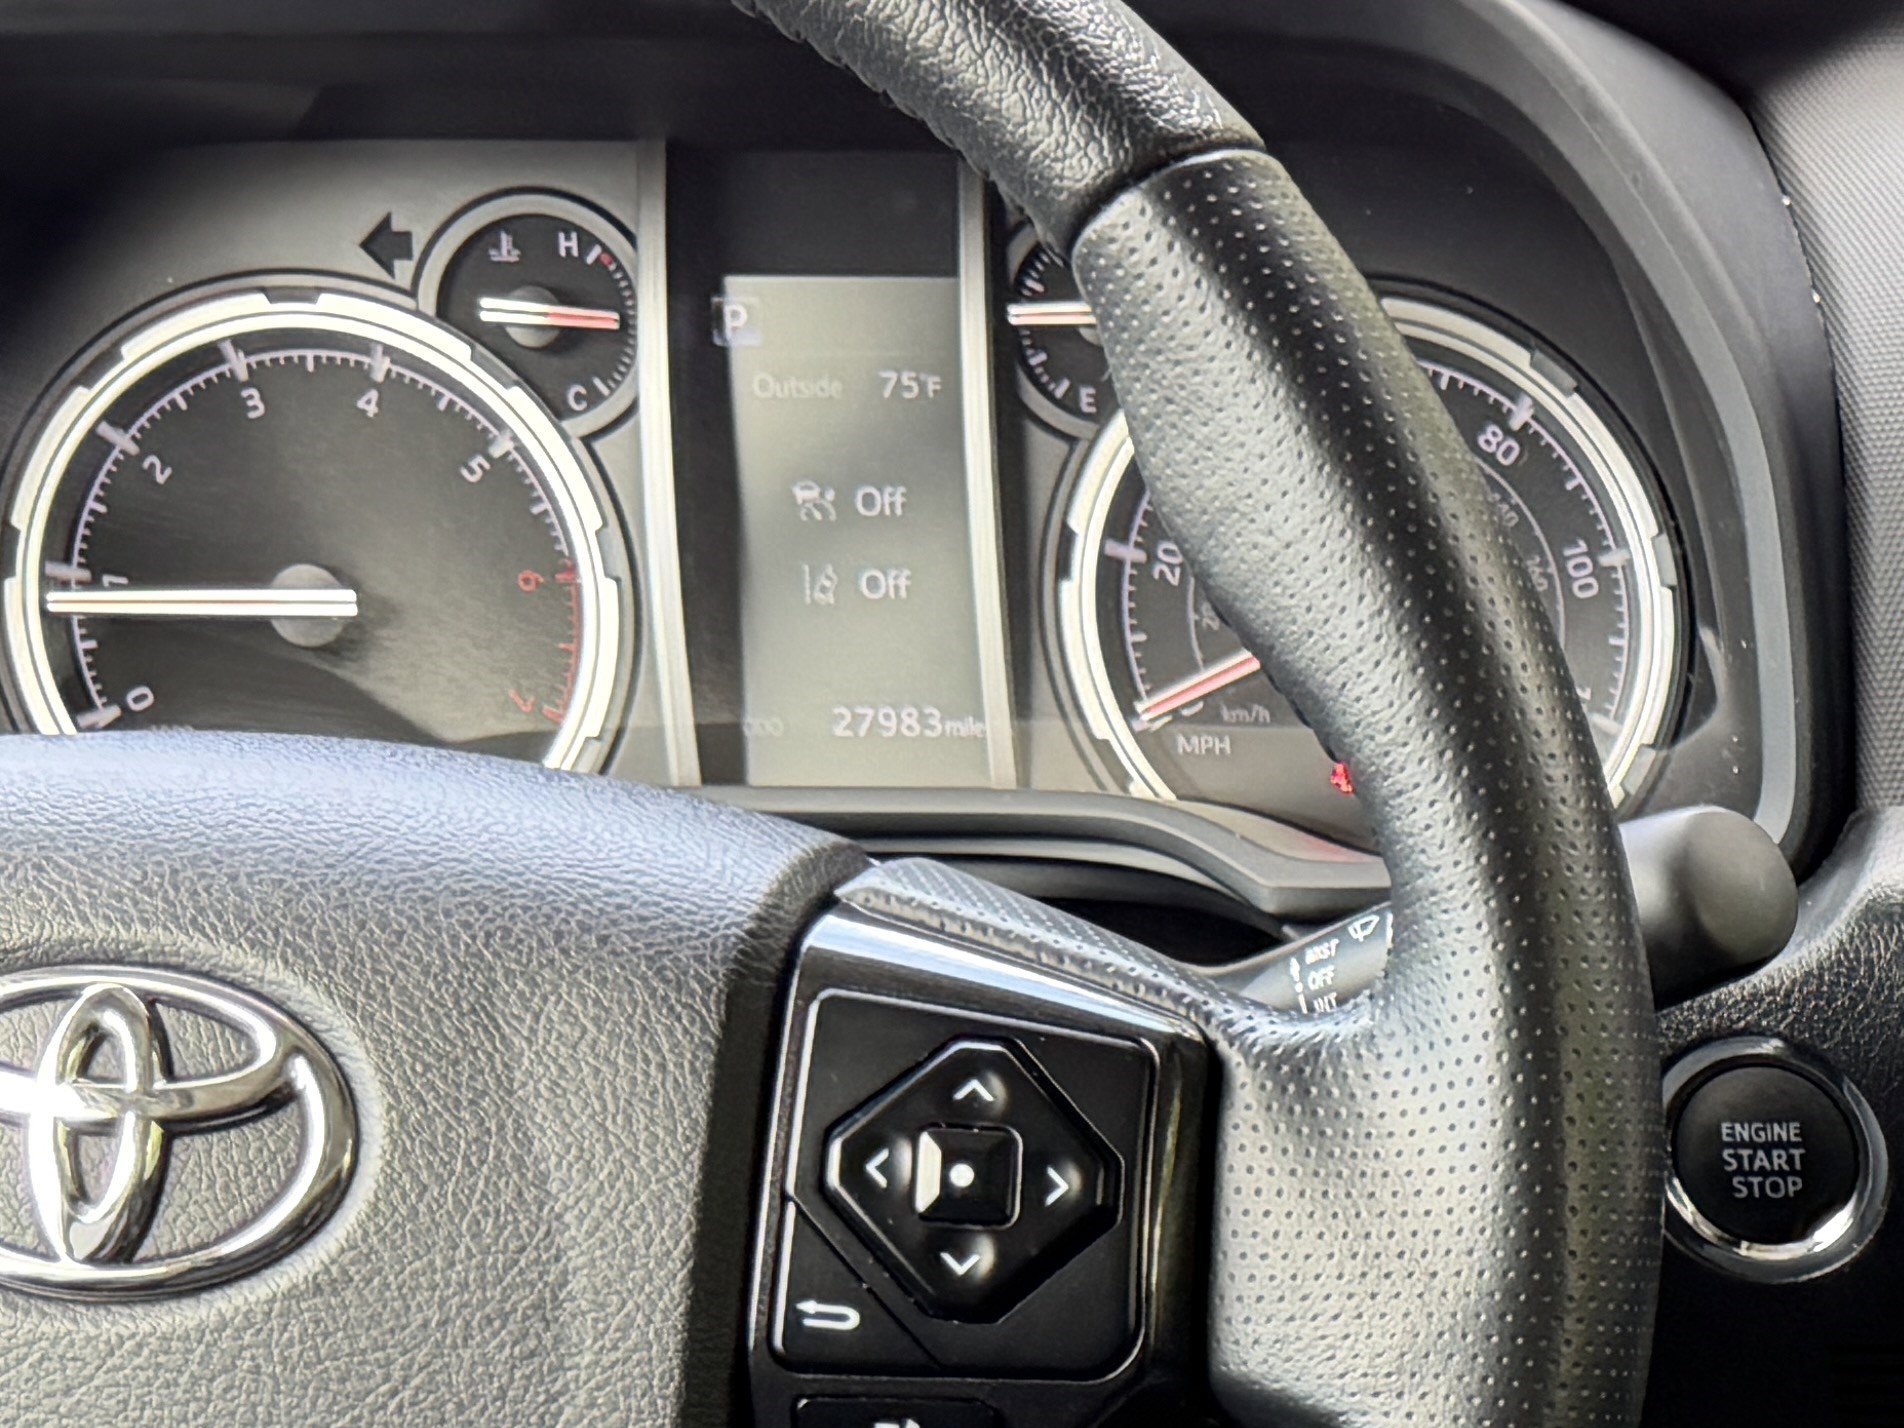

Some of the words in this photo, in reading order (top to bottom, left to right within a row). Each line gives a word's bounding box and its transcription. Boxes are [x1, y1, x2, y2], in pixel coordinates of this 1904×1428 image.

[558, 231, 578, 257] H
[566, 387, 589, 412] C
[752, 372, 843, 399] Outside
[1079, 386, 1097, 414] E
[239, 390, 266, 420] 3
[355, 389, 380, 419] 4
[1476, 422, 1521, 467] 80
[142, 453, 174, 485] 2
[458, 454, 491, 483] 5
[854, 485, 908, 517] Off
[1152, 540, 1187, 588] 20
[1562, 536, 1600, 600] 100
[516, 568, 545, 593] 6
[859, 568, 912, 600] Off
[831, 705, 944, 739] 27983
[943, 716, 986, 739] mile
[1175, 733, 1232, 756] MPH
[1720, 1121, 1803, 1143] ENGINE
[1721, 1148, 1806, 1173] START
[1731, 1175, 1803, 1200] STOP
